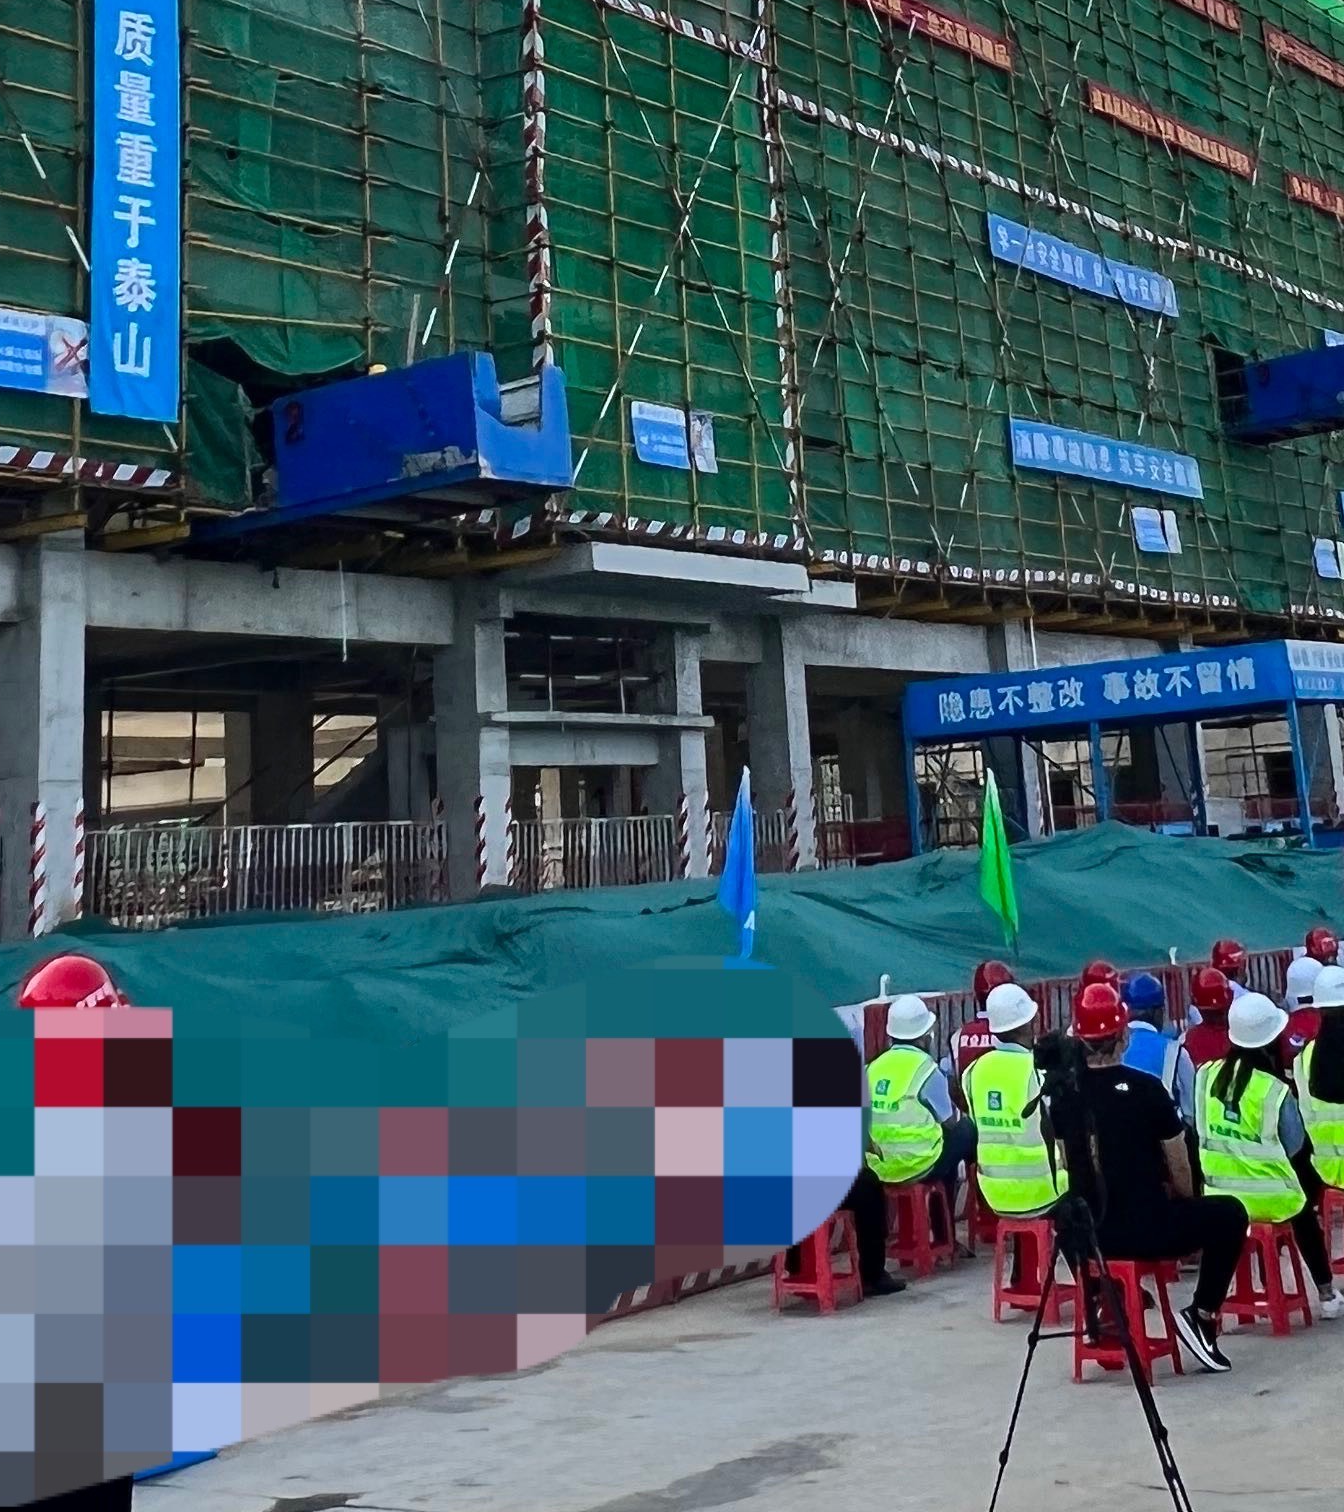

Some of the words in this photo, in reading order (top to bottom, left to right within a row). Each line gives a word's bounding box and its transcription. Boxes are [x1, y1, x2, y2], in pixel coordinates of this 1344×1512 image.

[111, 12, 158, 379] 质量重于泰山
[937, 677, 1086, 724] 隐患不整改
[1102, 655, 1258, 703] 事故不留情
